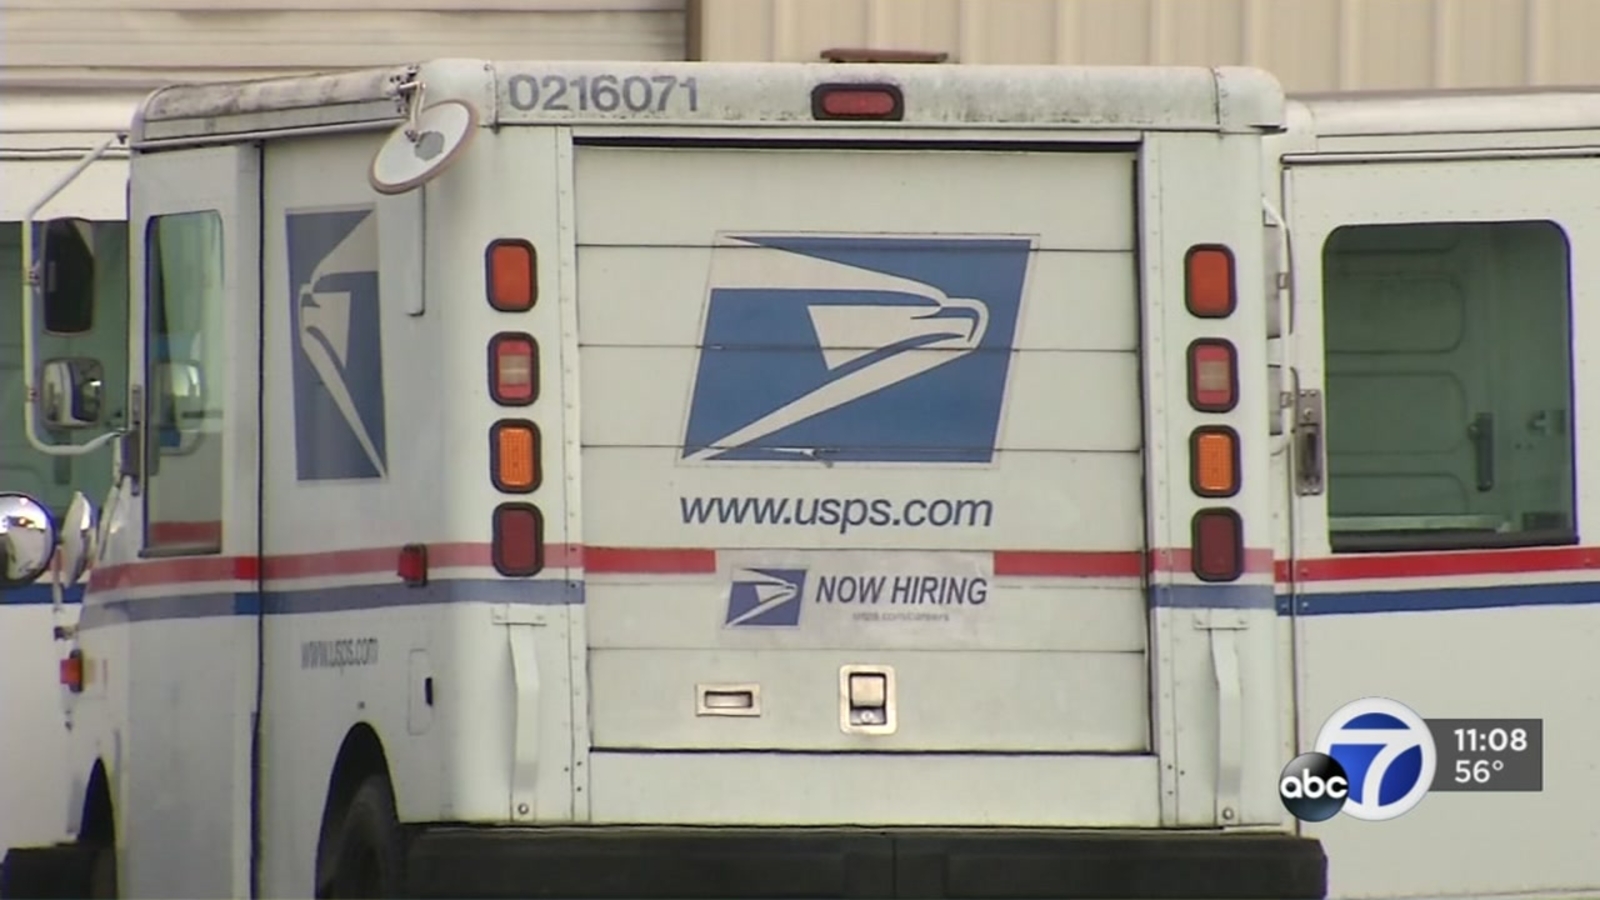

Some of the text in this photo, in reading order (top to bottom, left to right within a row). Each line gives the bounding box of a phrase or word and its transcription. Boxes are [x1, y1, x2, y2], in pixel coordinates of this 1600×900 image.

[508, 74, 697, 111] 0216071
[680, 496, 993, 533] www.usps.com
[815, 576, 987, 605] NOW HIRING
